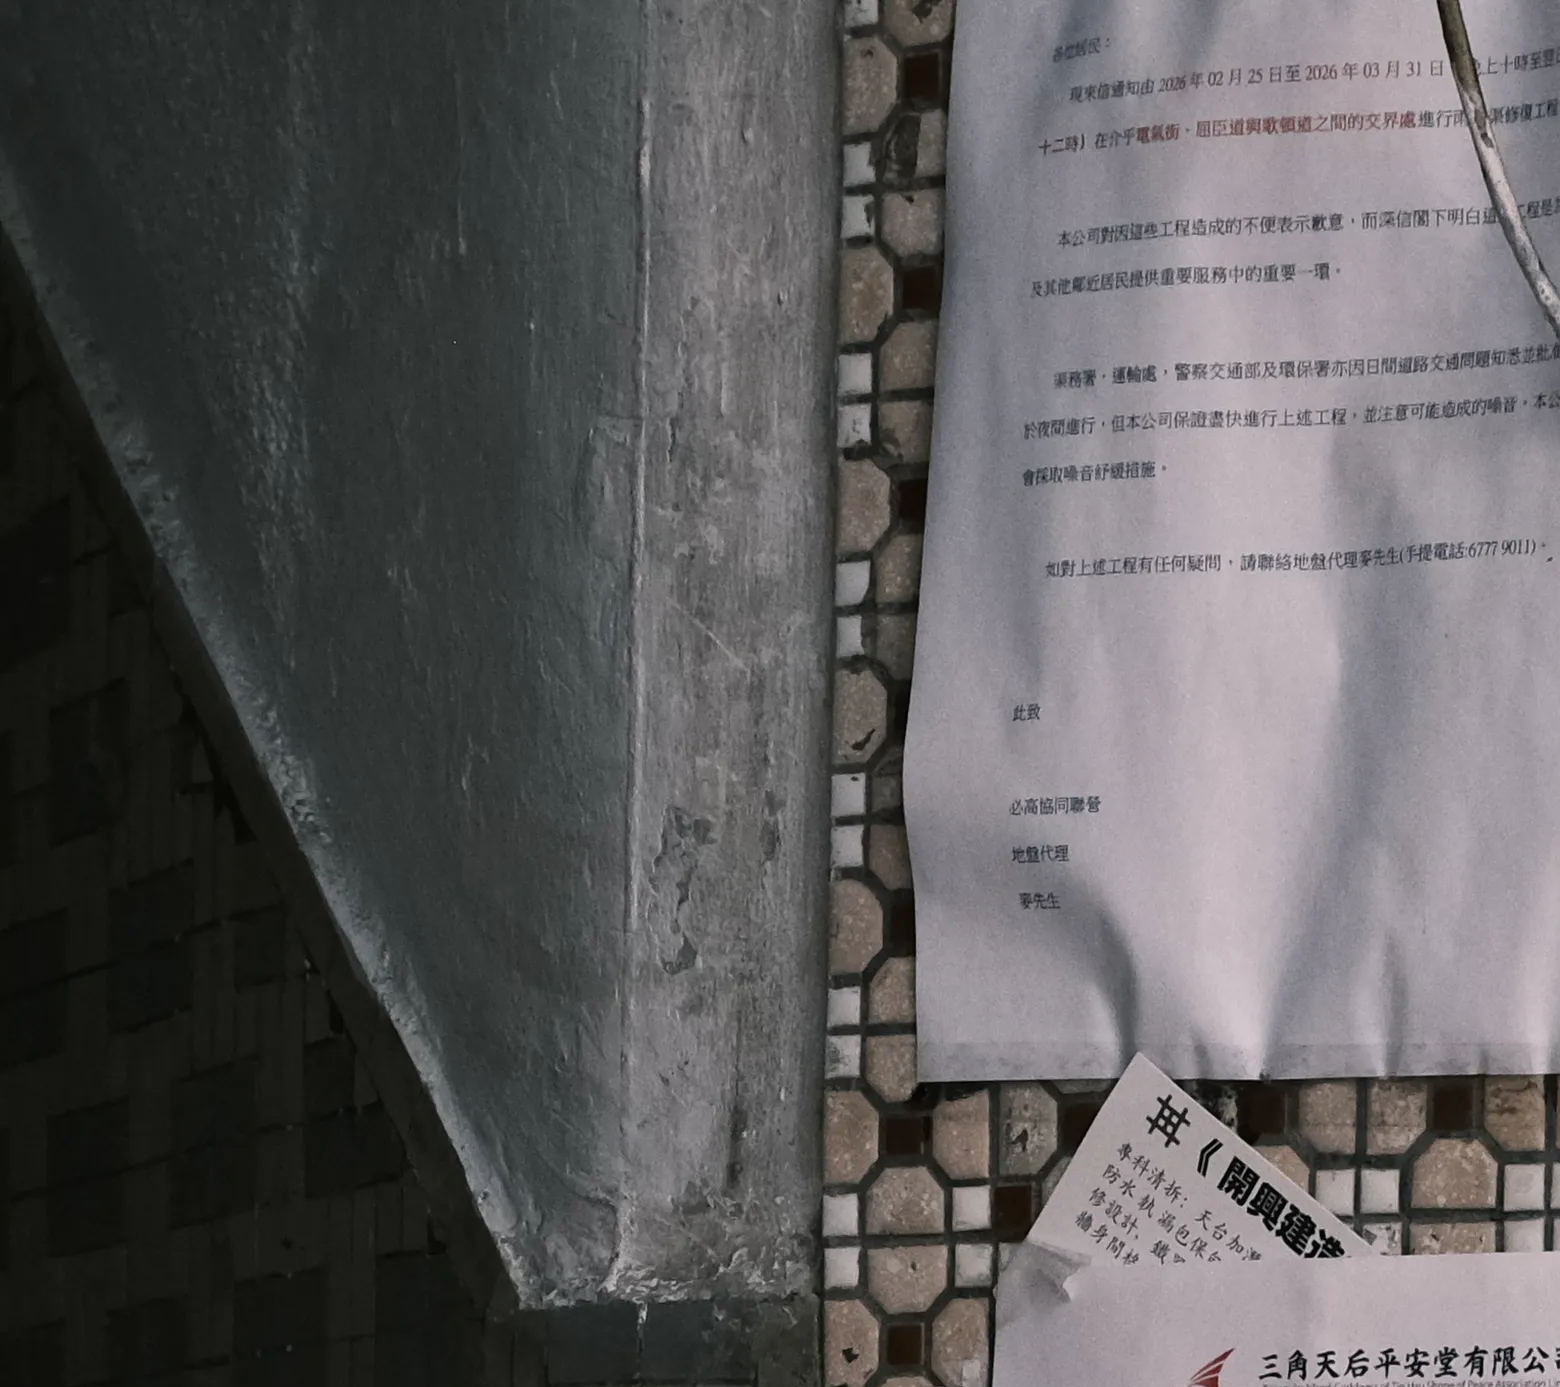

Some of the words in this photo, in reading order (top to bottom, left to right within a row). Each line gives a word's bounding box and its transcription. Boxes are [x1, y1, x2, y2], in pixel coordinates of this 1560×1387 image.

[1158, 74, 1187, 92] 2026
[1190, 73, 1205, 90] 年
[1207, 71, 1223, 87] 02
[1228, 68, 1243, 85] 月
[1247, 68, 1263, 84] 25
[1305, 63, 1338, 81] 2026
[1342, 61, 1359, 80] 年
[1363, 61, 1380, 78] 03
[1386, 60, 1400, 79] 月
[1406, 60, 1422, 78] 31
[1013, 703, 1041, 722] 此致
[1012, 845, 1069, 864] 地盤代理
